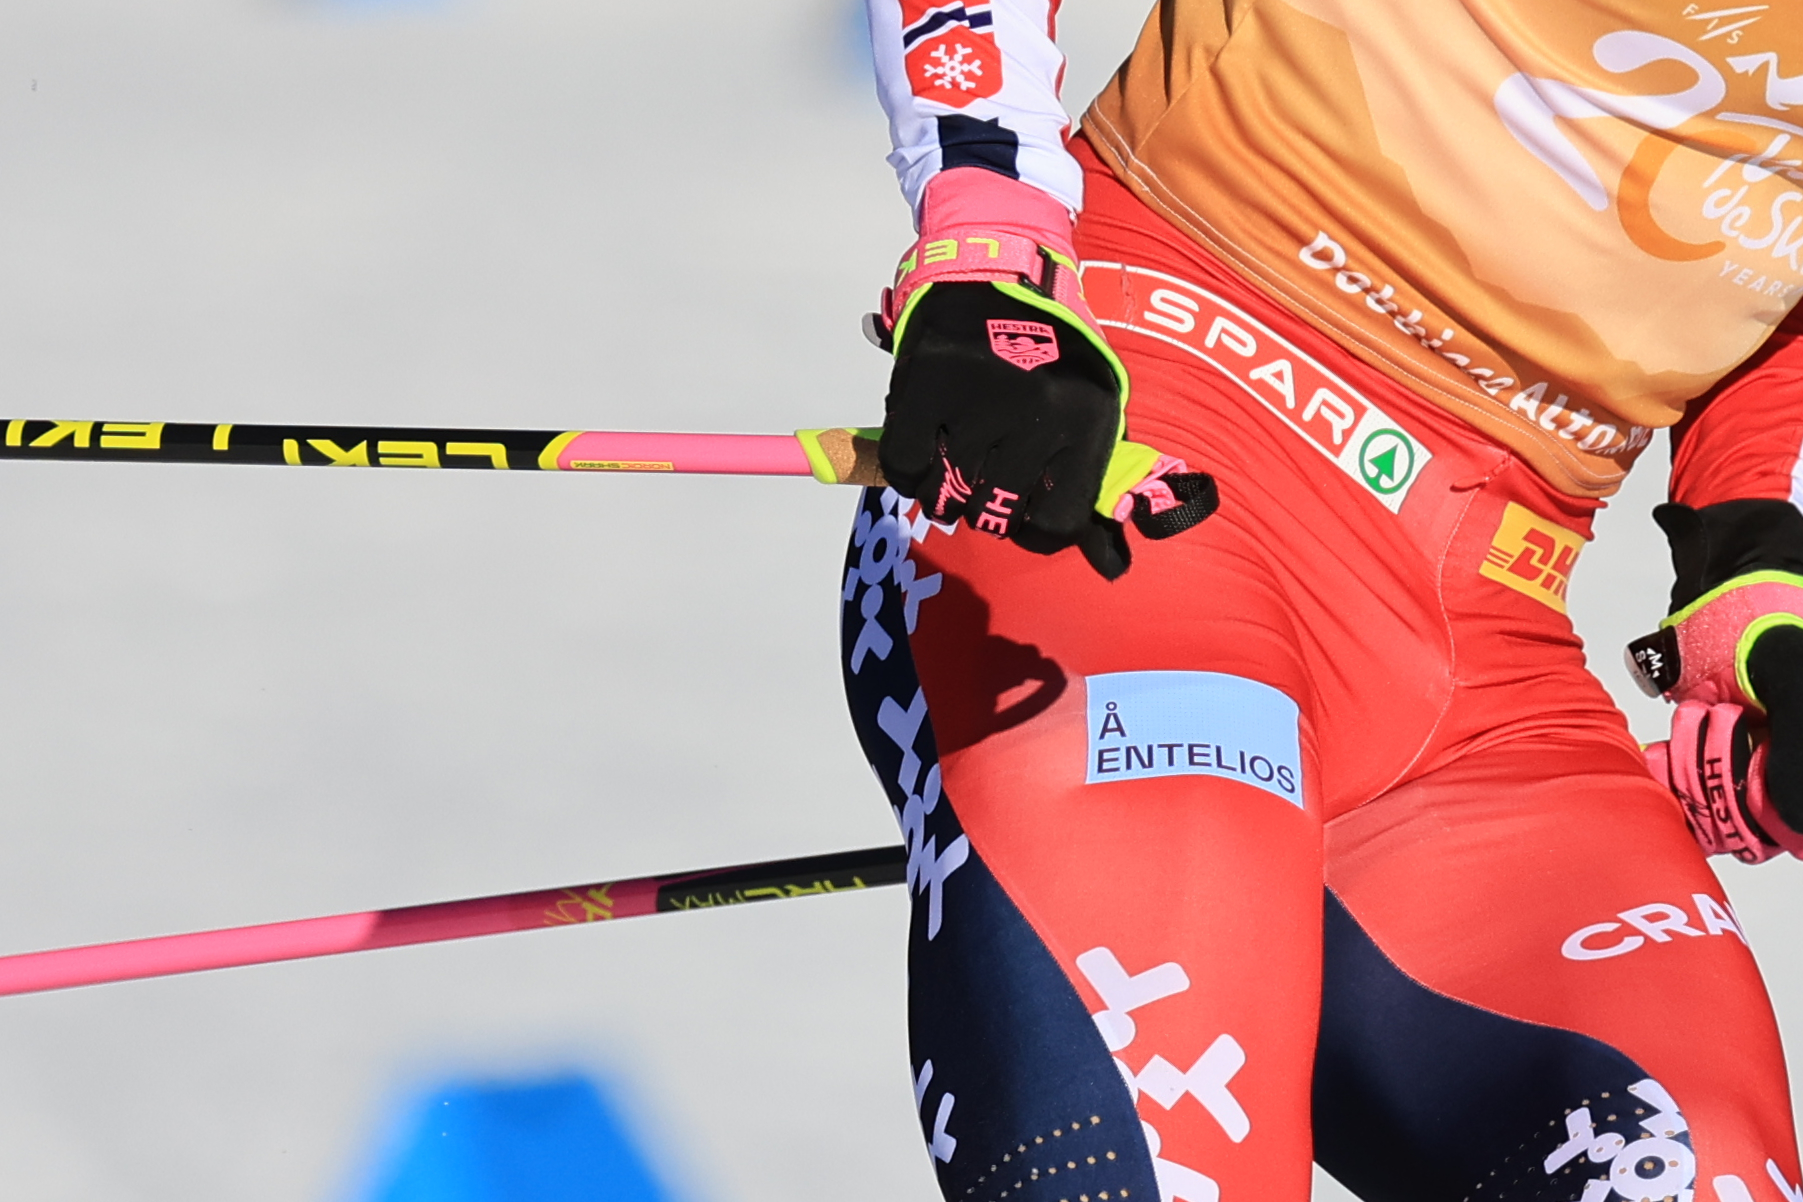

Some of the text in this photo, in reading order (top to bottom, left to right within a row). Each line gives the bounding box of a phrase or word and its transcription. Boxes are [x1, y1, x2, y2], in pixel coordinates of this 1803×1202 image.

[896, 237, 1000, 287] LEK
[1719, 260, 1796, 298] YEARS
[990, 323, 1051, 335] HESTRA
[1143, 288, 1356, 446] SPAR
[283, 439, 510, 469] LEKI
[1506, 526, 1579, 603] DH
[1099, 701, 1127, 740] Å
[1097, 743, 1296, 794] ENTELIOS
[1705, 757, 1759, 865] HESTR
[1561, 893, 1748, 961] CRA
